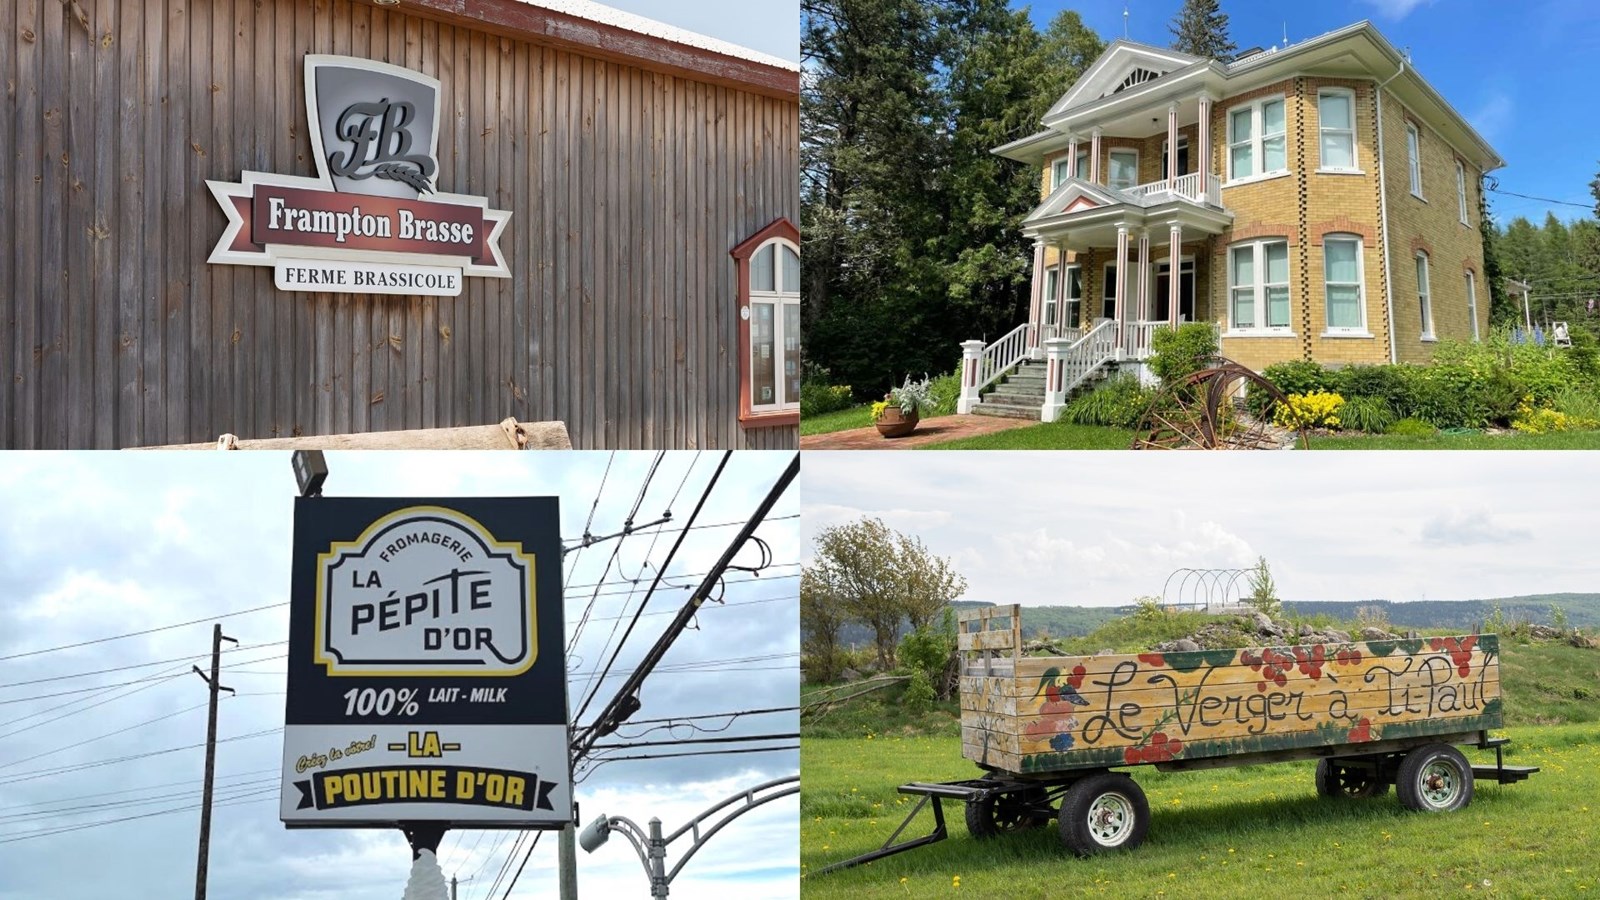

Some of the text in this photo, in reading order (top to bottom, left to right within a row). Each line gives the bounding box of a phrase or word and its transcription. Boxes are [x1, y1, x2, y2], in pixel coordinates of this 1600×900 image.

[268, 197, 474, 245] Frampton Brasse
[285, 267, 456, 289] FERME BRASSICOLE
[379, 531, 473, 563] FROMAGERIE
[352, 570, 382, 588] LA
[351, 568, 493, 636] PÉPITE
[424, 627, 493, 651] D'OR
[343, 687, 419, 716] 100%
[428, 687, 460, 703] LAIT
[470, 687, 508, 703] MILK
[1082, 648, 1496, 744] Le Verger à Ti-Paul
[296, 752, 328, 774] Créez
[329, 747, 343, 761] la
[323, 770, 526, 806] POUTINE D'OR
